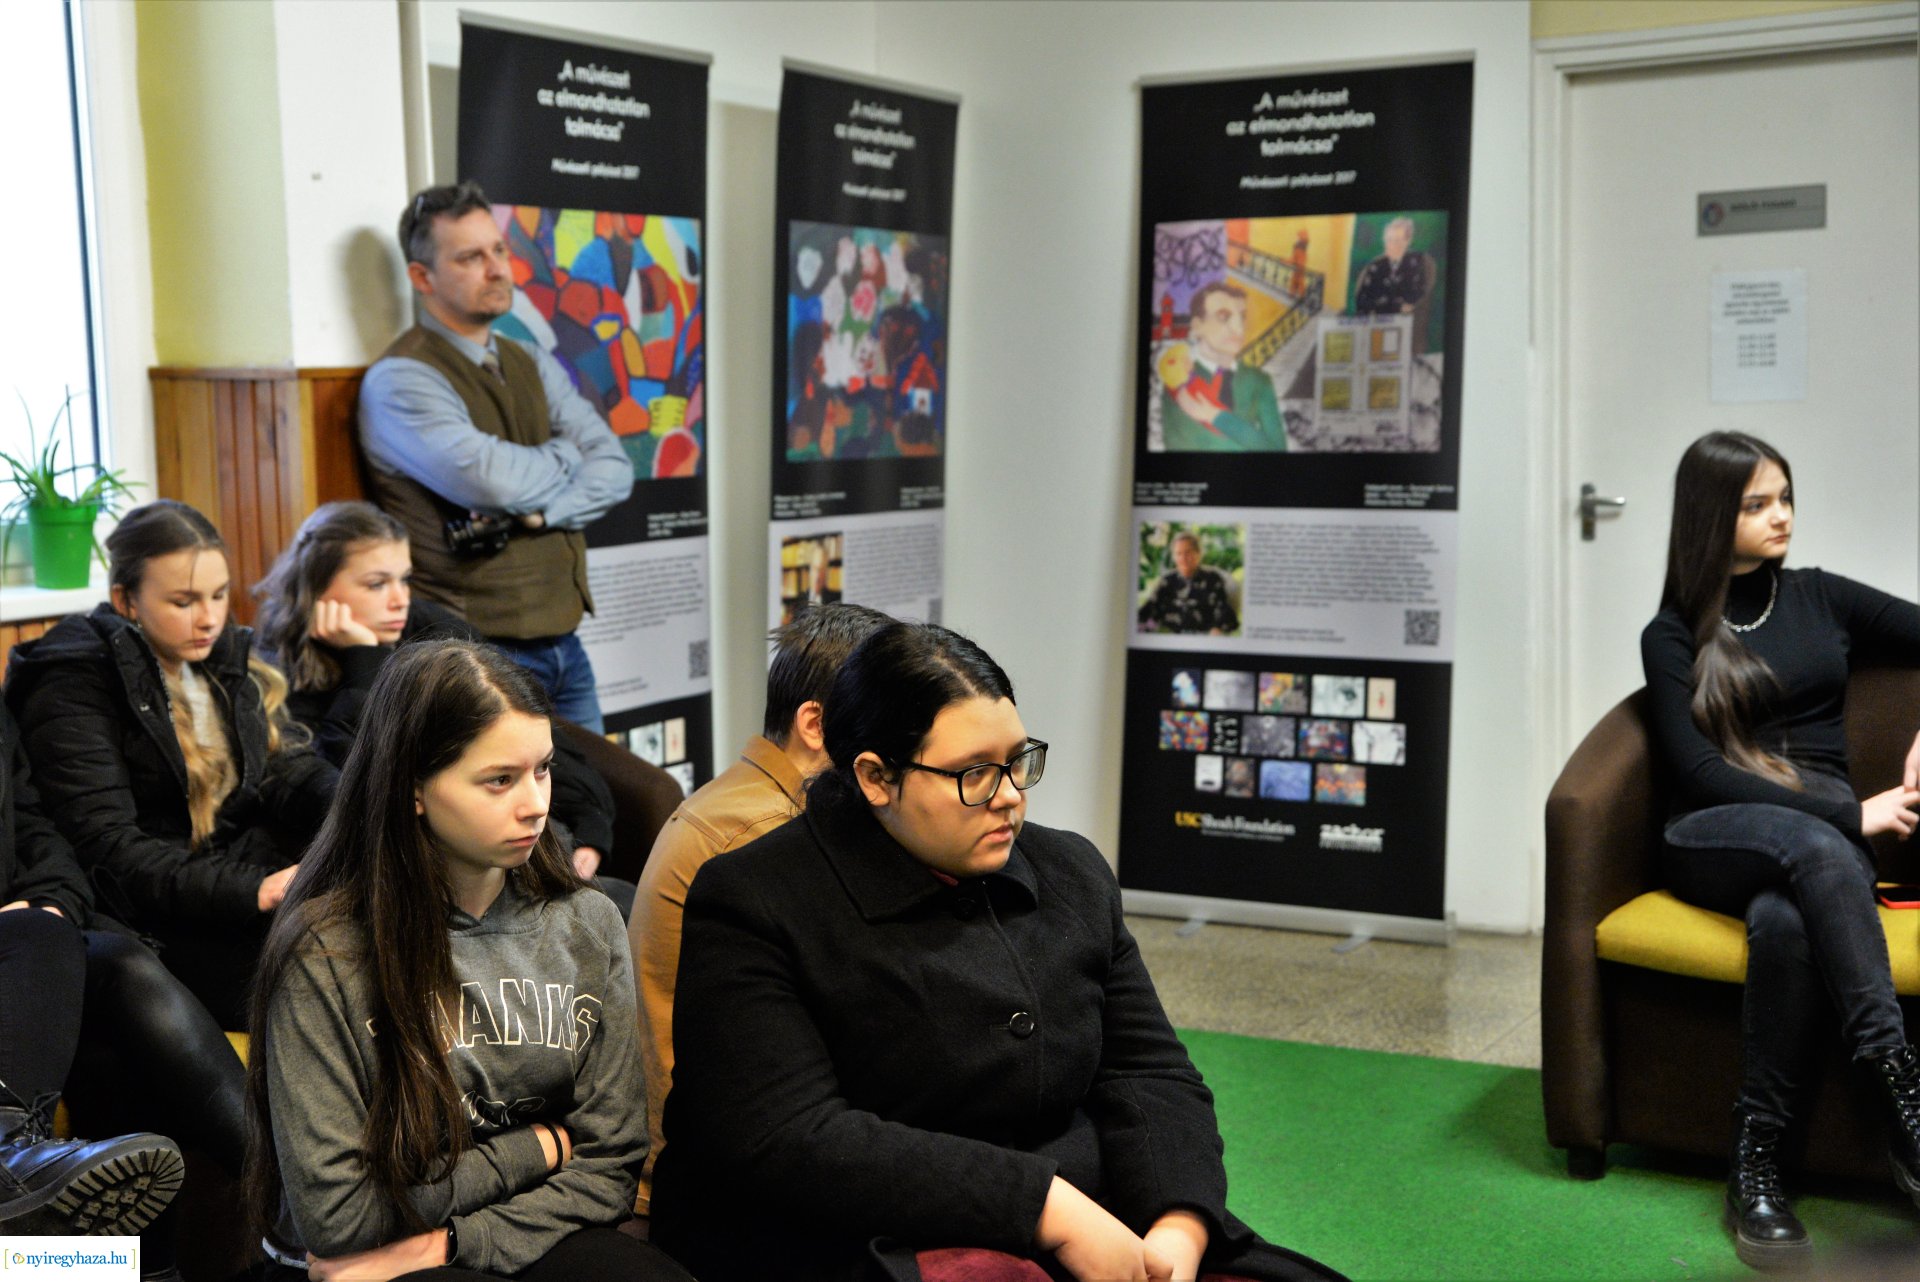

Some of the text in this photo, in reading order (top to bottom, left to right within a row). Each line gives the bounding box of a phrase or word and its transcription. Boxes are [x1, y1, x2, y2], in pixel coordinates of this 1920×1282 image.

[537, 87, 651, 119] az elmondhatatlan
[1226, 109, 1376, 136] az elmondhatatlan
[1174, 811, 1201, 829] USC
[1234, 815, 1296, 836] Foundation
